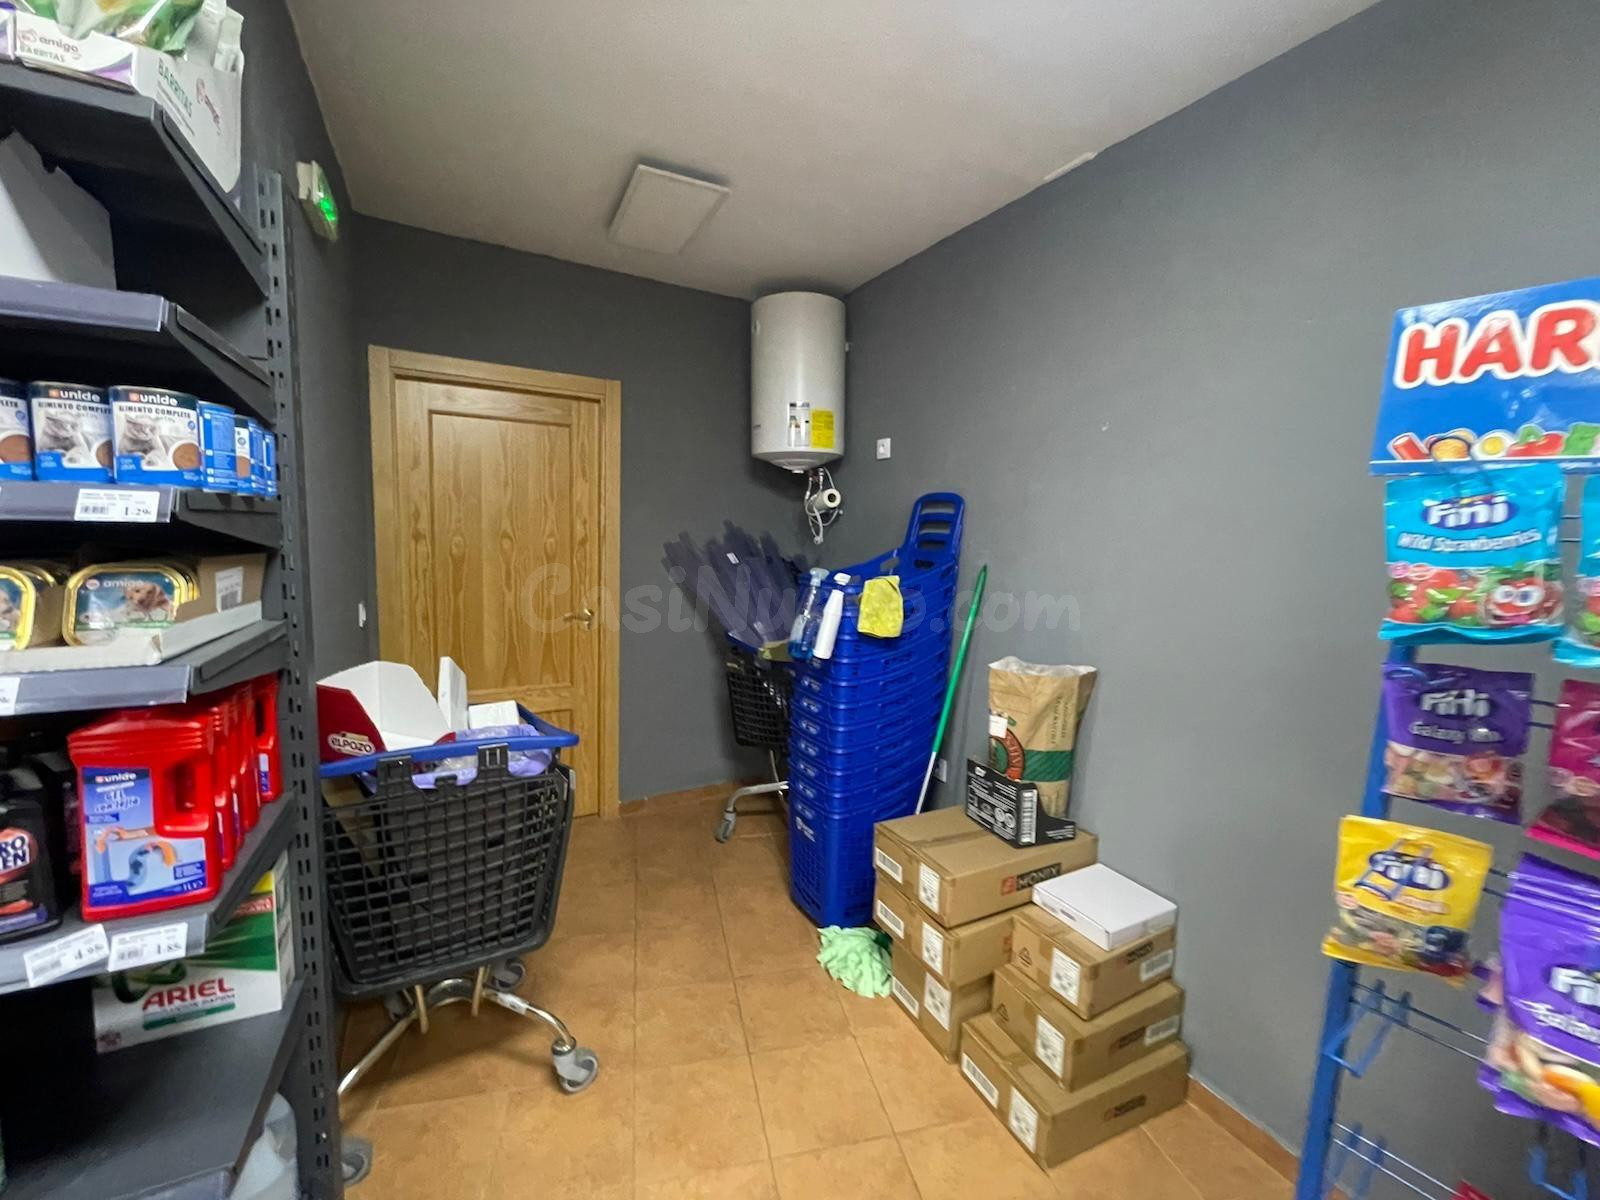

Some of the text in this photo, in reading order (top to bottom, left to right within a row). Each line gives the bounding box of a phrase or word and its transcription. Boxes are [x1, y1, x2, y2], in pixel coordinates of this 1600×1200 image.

[39, 36, 79, 53] amigo
[1401, 304, 1597, 384] HAR
[60, 390, 100, 402] unide
[140, 393, 178, 406] unide
[1425, 495, 1509, 528] Fini
[142, 978, 235, 1011] ARIEL
